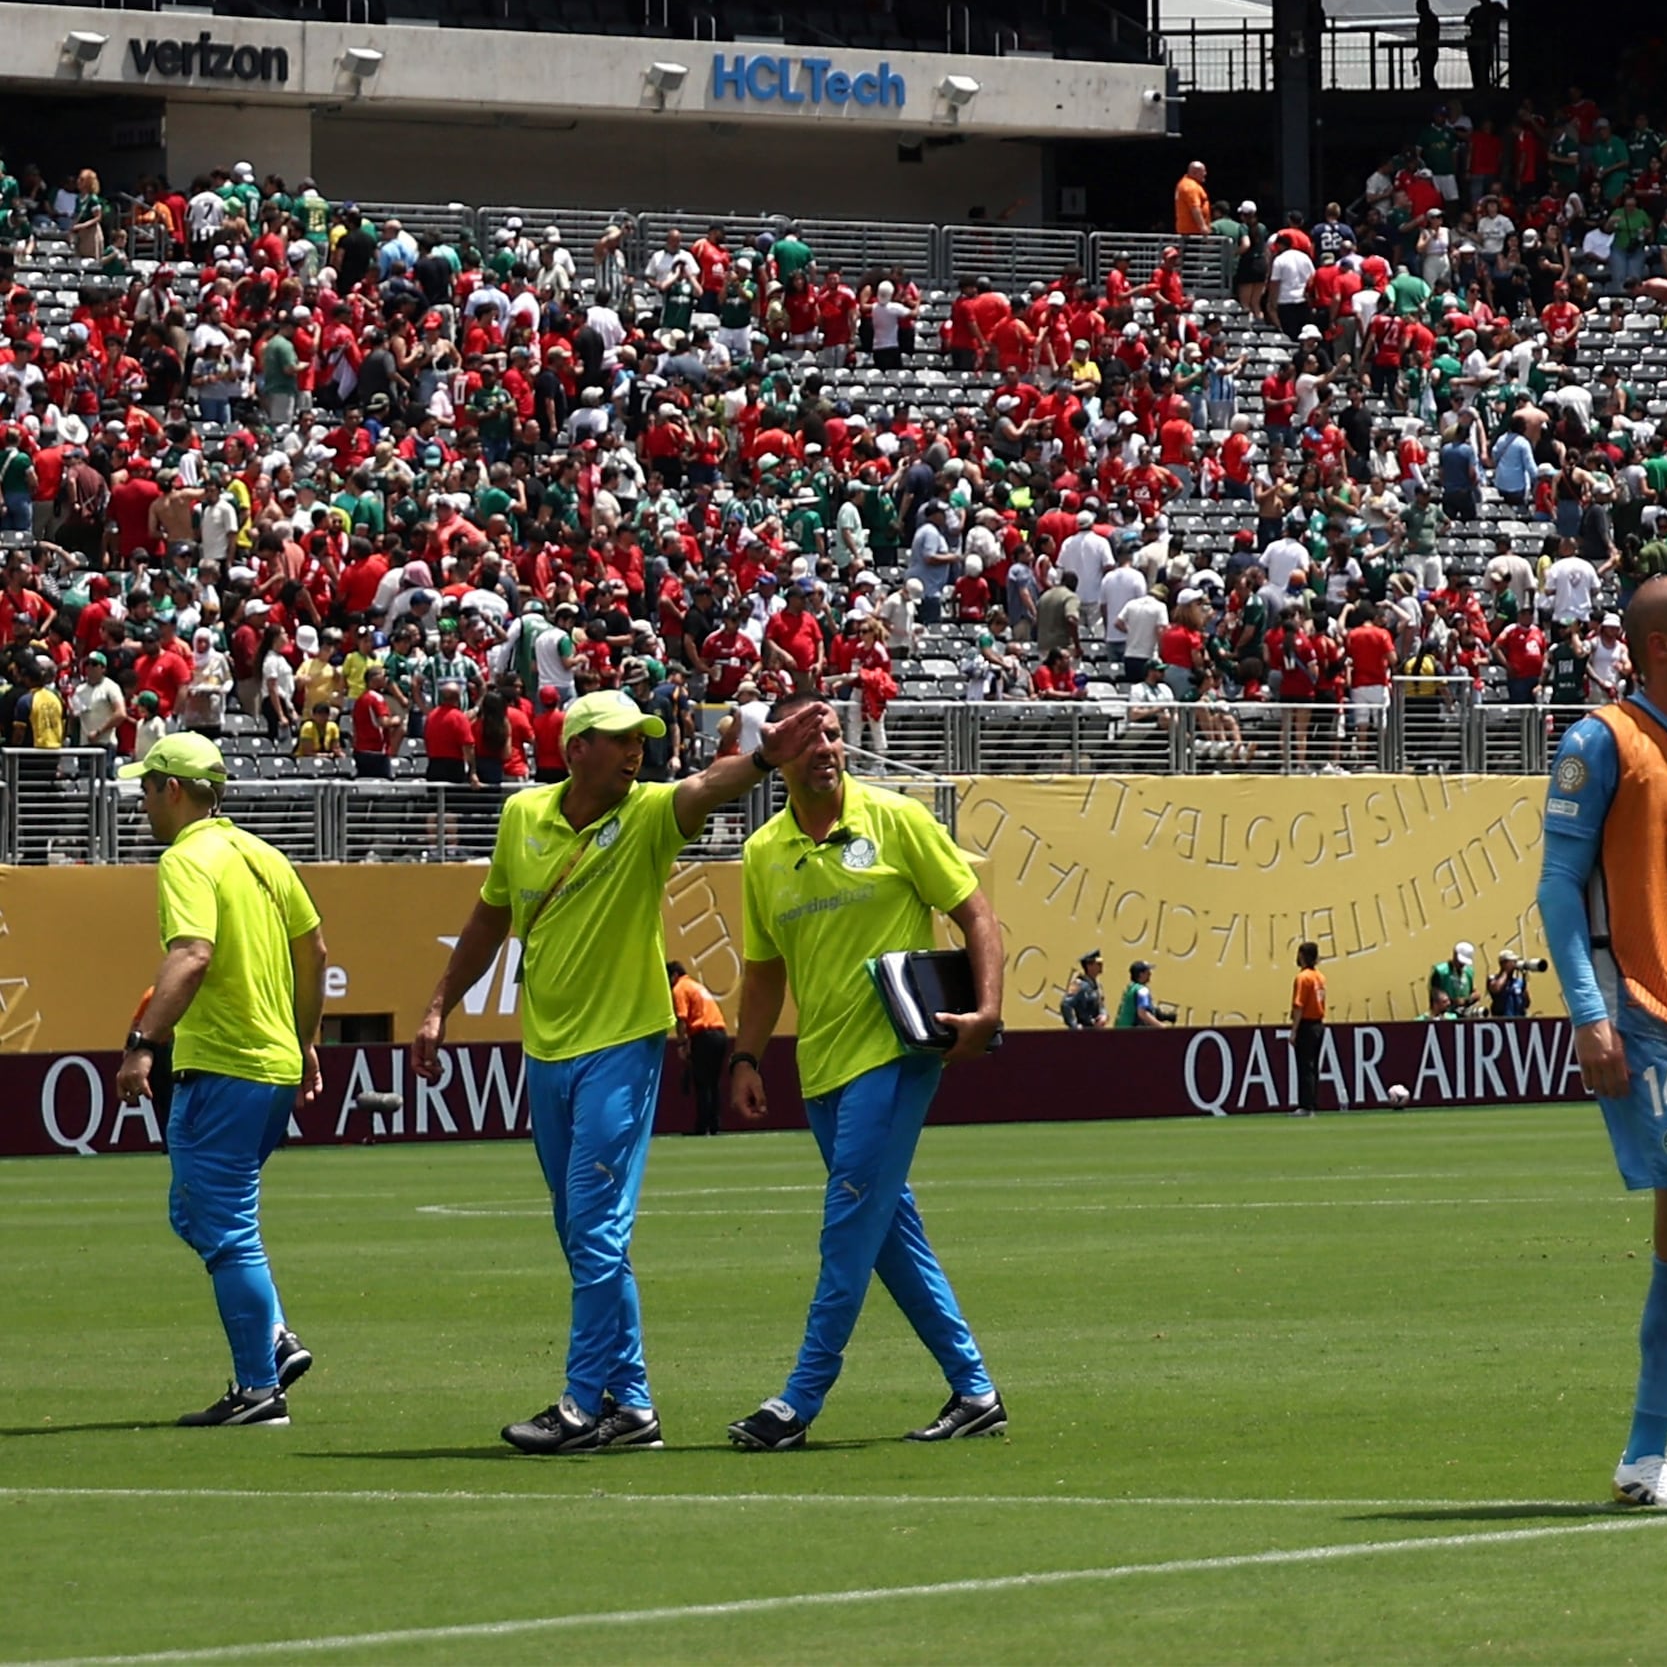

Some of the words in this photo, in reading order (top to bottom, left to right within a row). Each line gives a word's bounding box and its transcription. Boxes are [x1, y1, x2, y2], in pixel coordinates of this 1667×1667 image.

[128, 30, 290, 83] verizon
[712, 52, 906, 108] HCLTech
[202, 201, 214, 219] 7
[639, 389, 652, 413] 7
[335, 1046, 532, 1138] AIRW
